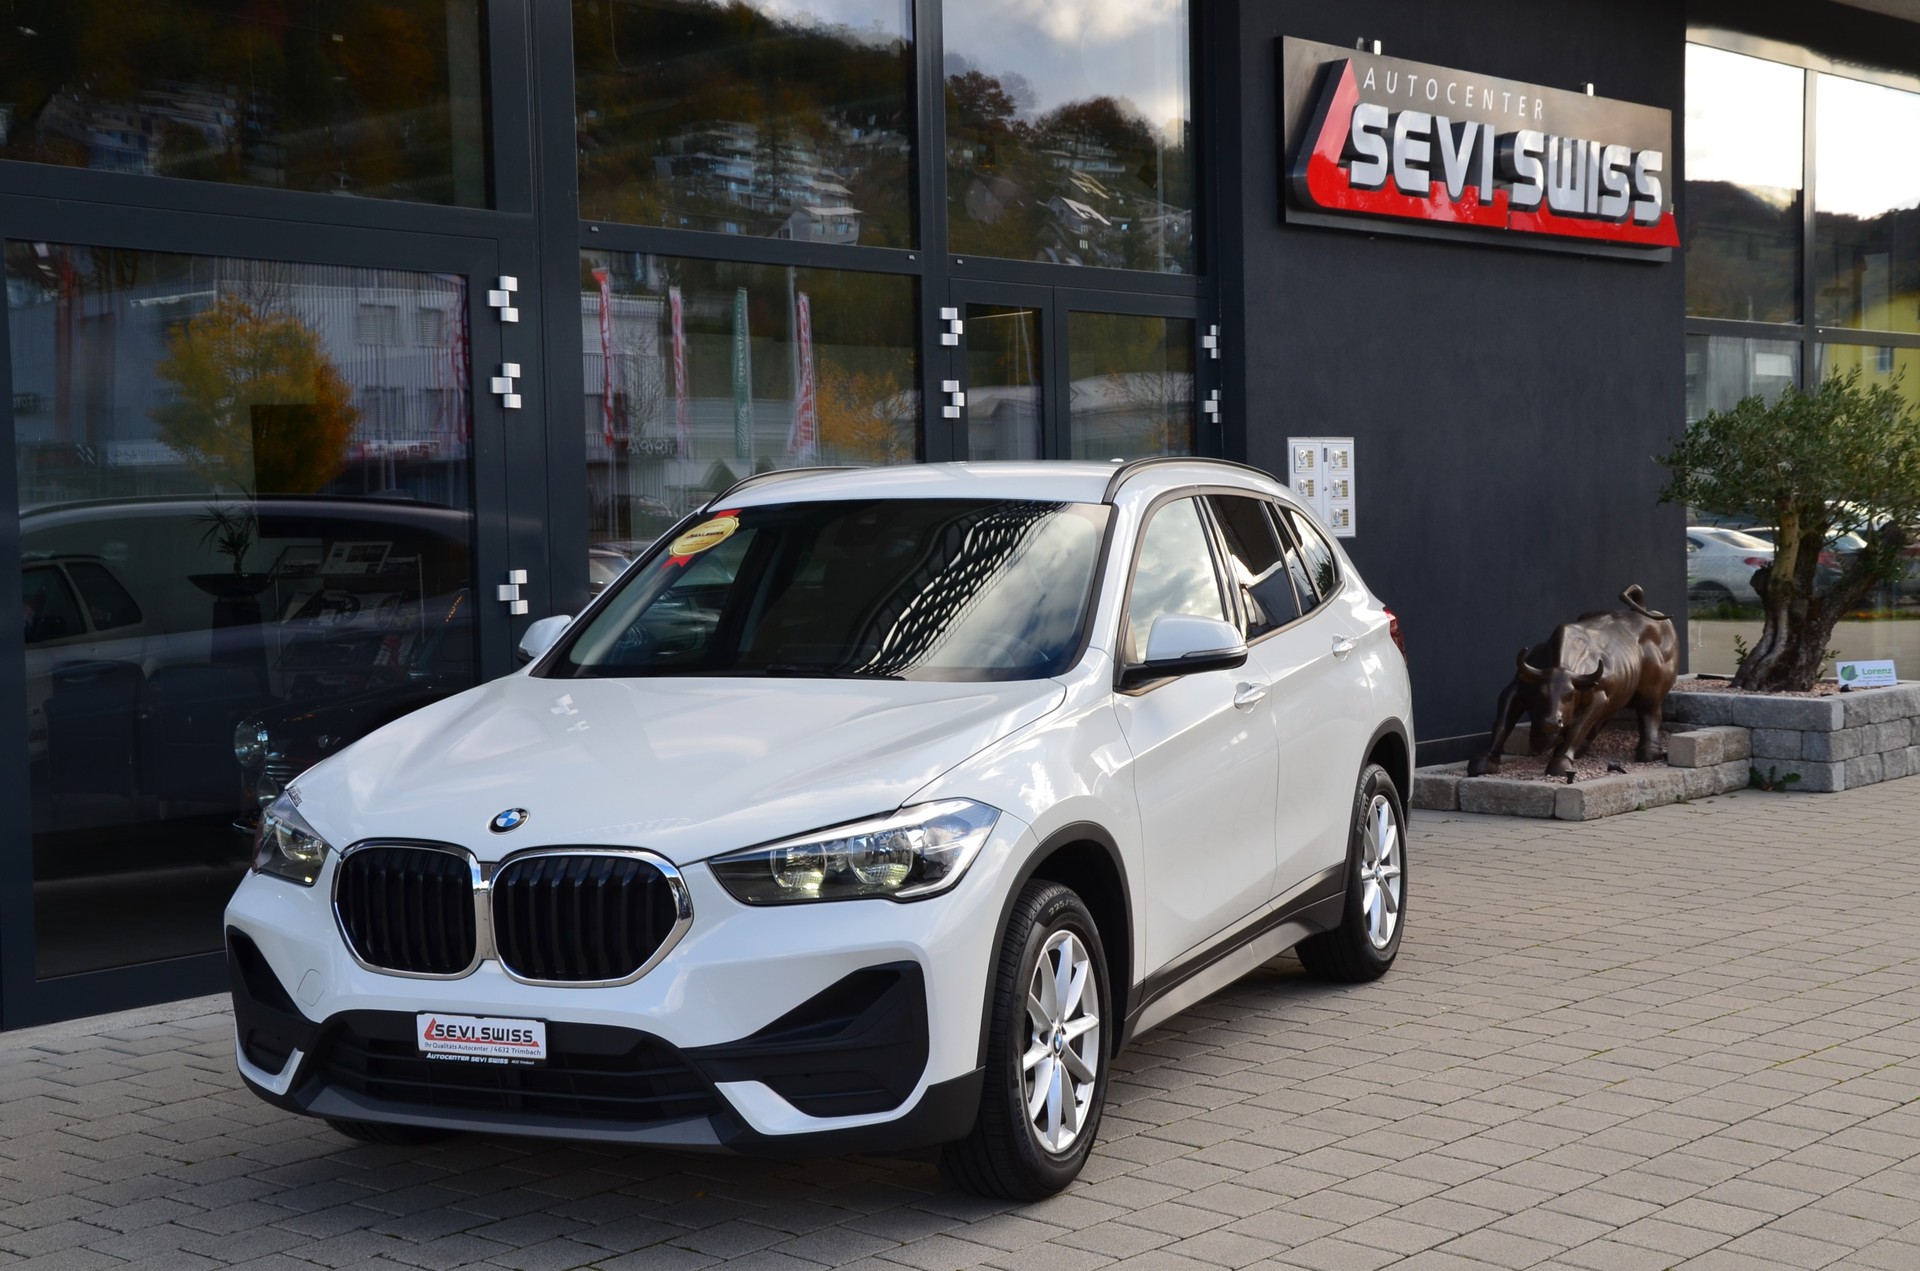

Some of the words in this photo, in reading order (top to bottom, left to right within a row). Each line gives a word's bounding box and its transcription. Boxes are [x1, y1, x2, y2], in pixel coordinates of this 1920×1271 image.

[1363, 67, 1543, 120] AUTOCENTER
[1350, 102, 1495, 202] SEVI
[1512, 128, 1663, 222] SWISS
[435, 1024, 475, 1039] SEVI
[481, 1027, 533, 1043] SWISS
[458, 1044, 489, 1052] Autocenter
[494, 1046, 509, 1054] 4632
[511, 1047, 541, 1056] Trimbach
[487, 1057, 509, 1065] SWISS
